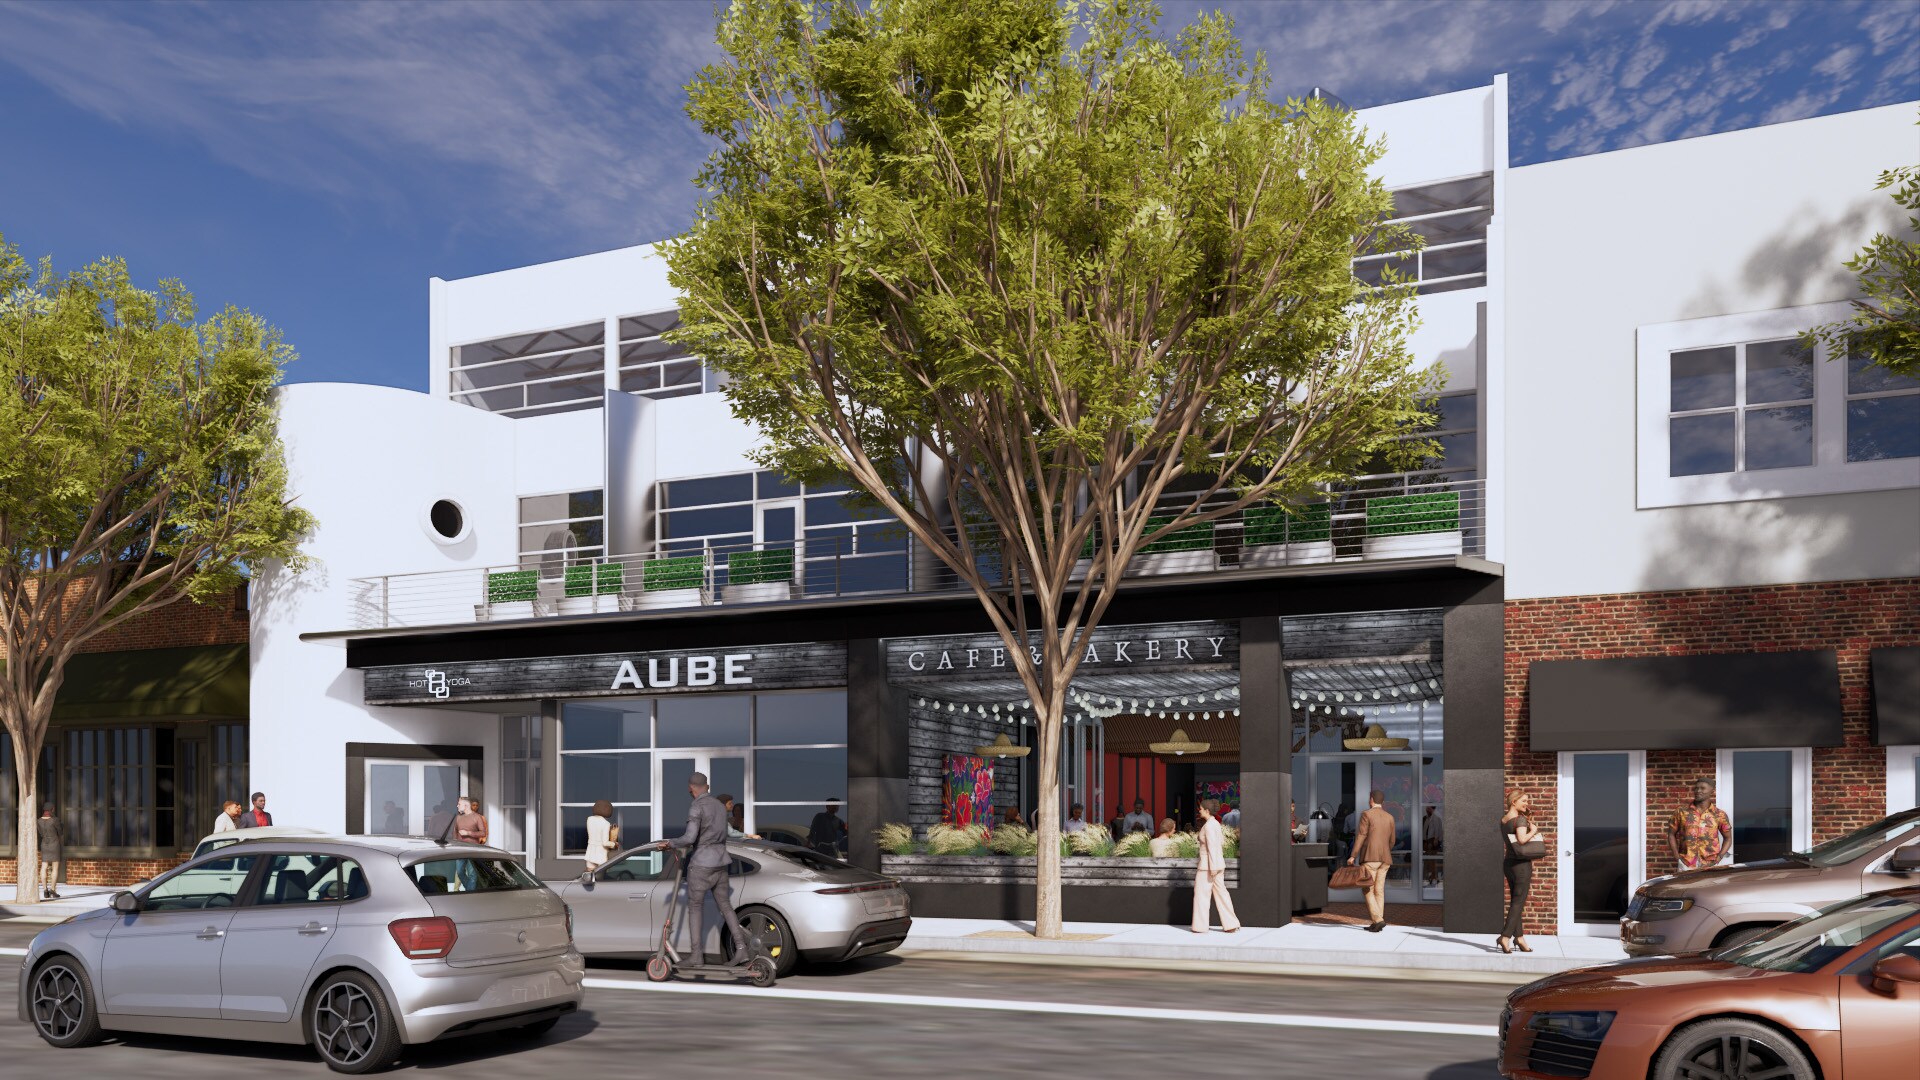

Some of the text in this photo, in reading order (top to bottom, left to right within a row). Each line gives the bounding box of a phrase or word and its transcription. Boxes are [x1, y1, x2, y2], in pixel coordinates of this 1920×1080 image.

[908, 647, 1005, 671] CAFE
[1065, 636, 1226, 664] AKERY
[409, 679, 428, 688] HOT
[445, 677, 471, 686] YOGA
[610, 653, 753, 690] AUBE
